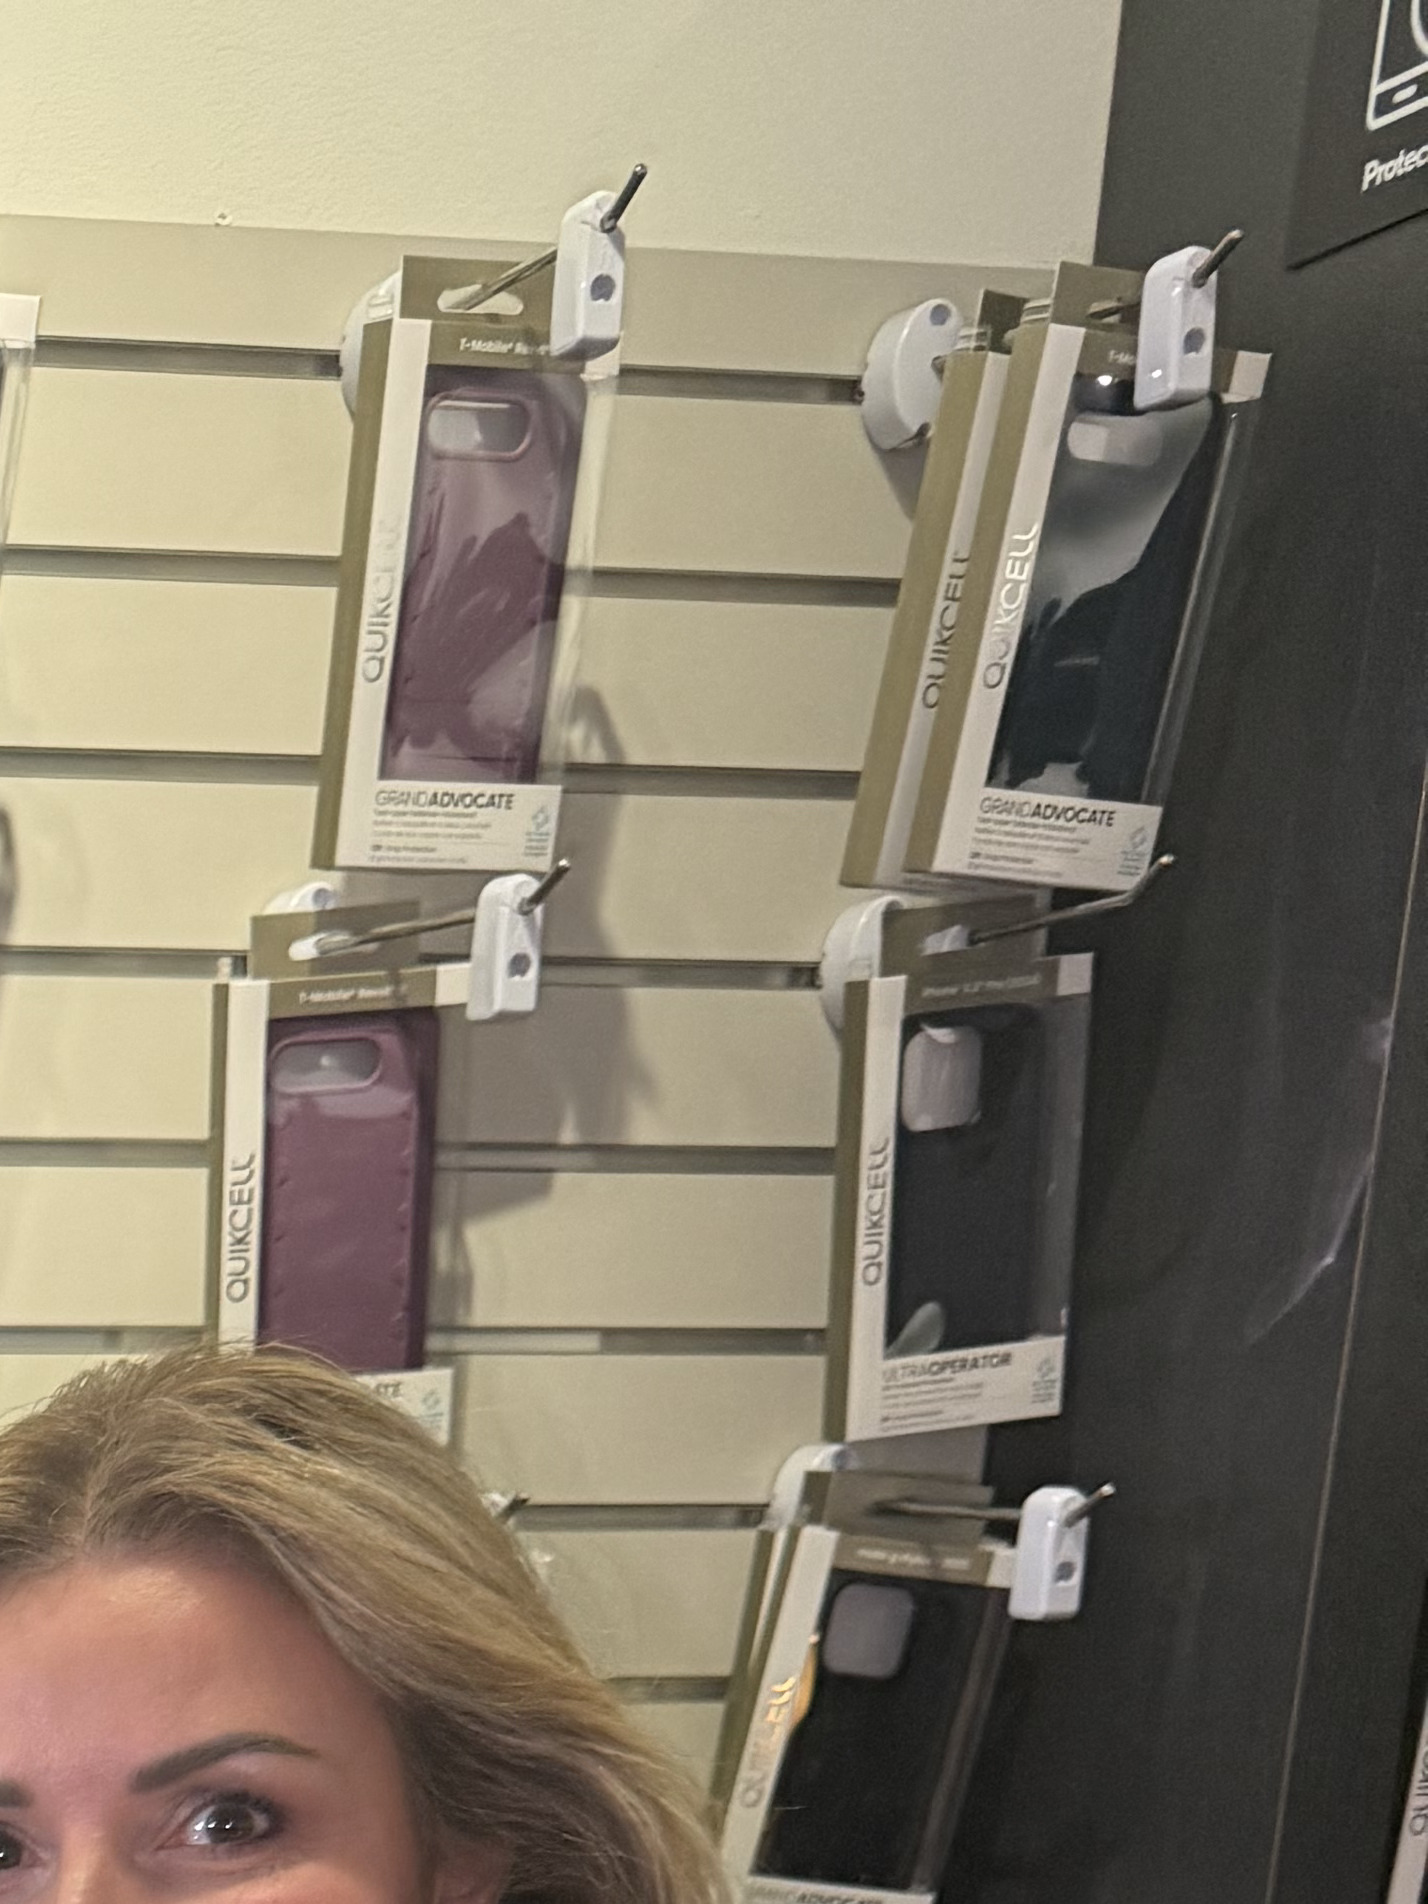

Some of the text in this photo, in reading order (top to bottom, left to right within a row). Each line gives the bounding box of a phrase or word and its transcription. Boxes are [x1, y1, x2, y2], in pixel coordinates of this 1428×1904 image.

[983, 522, 1039, 689] QUIKCELL
[374, 789, 515, 811] GRANDADVOCATE
[225, 1151, 255, 1304] QUIKCELL
[862, 1136, 890, 1287] QUIKCELL
